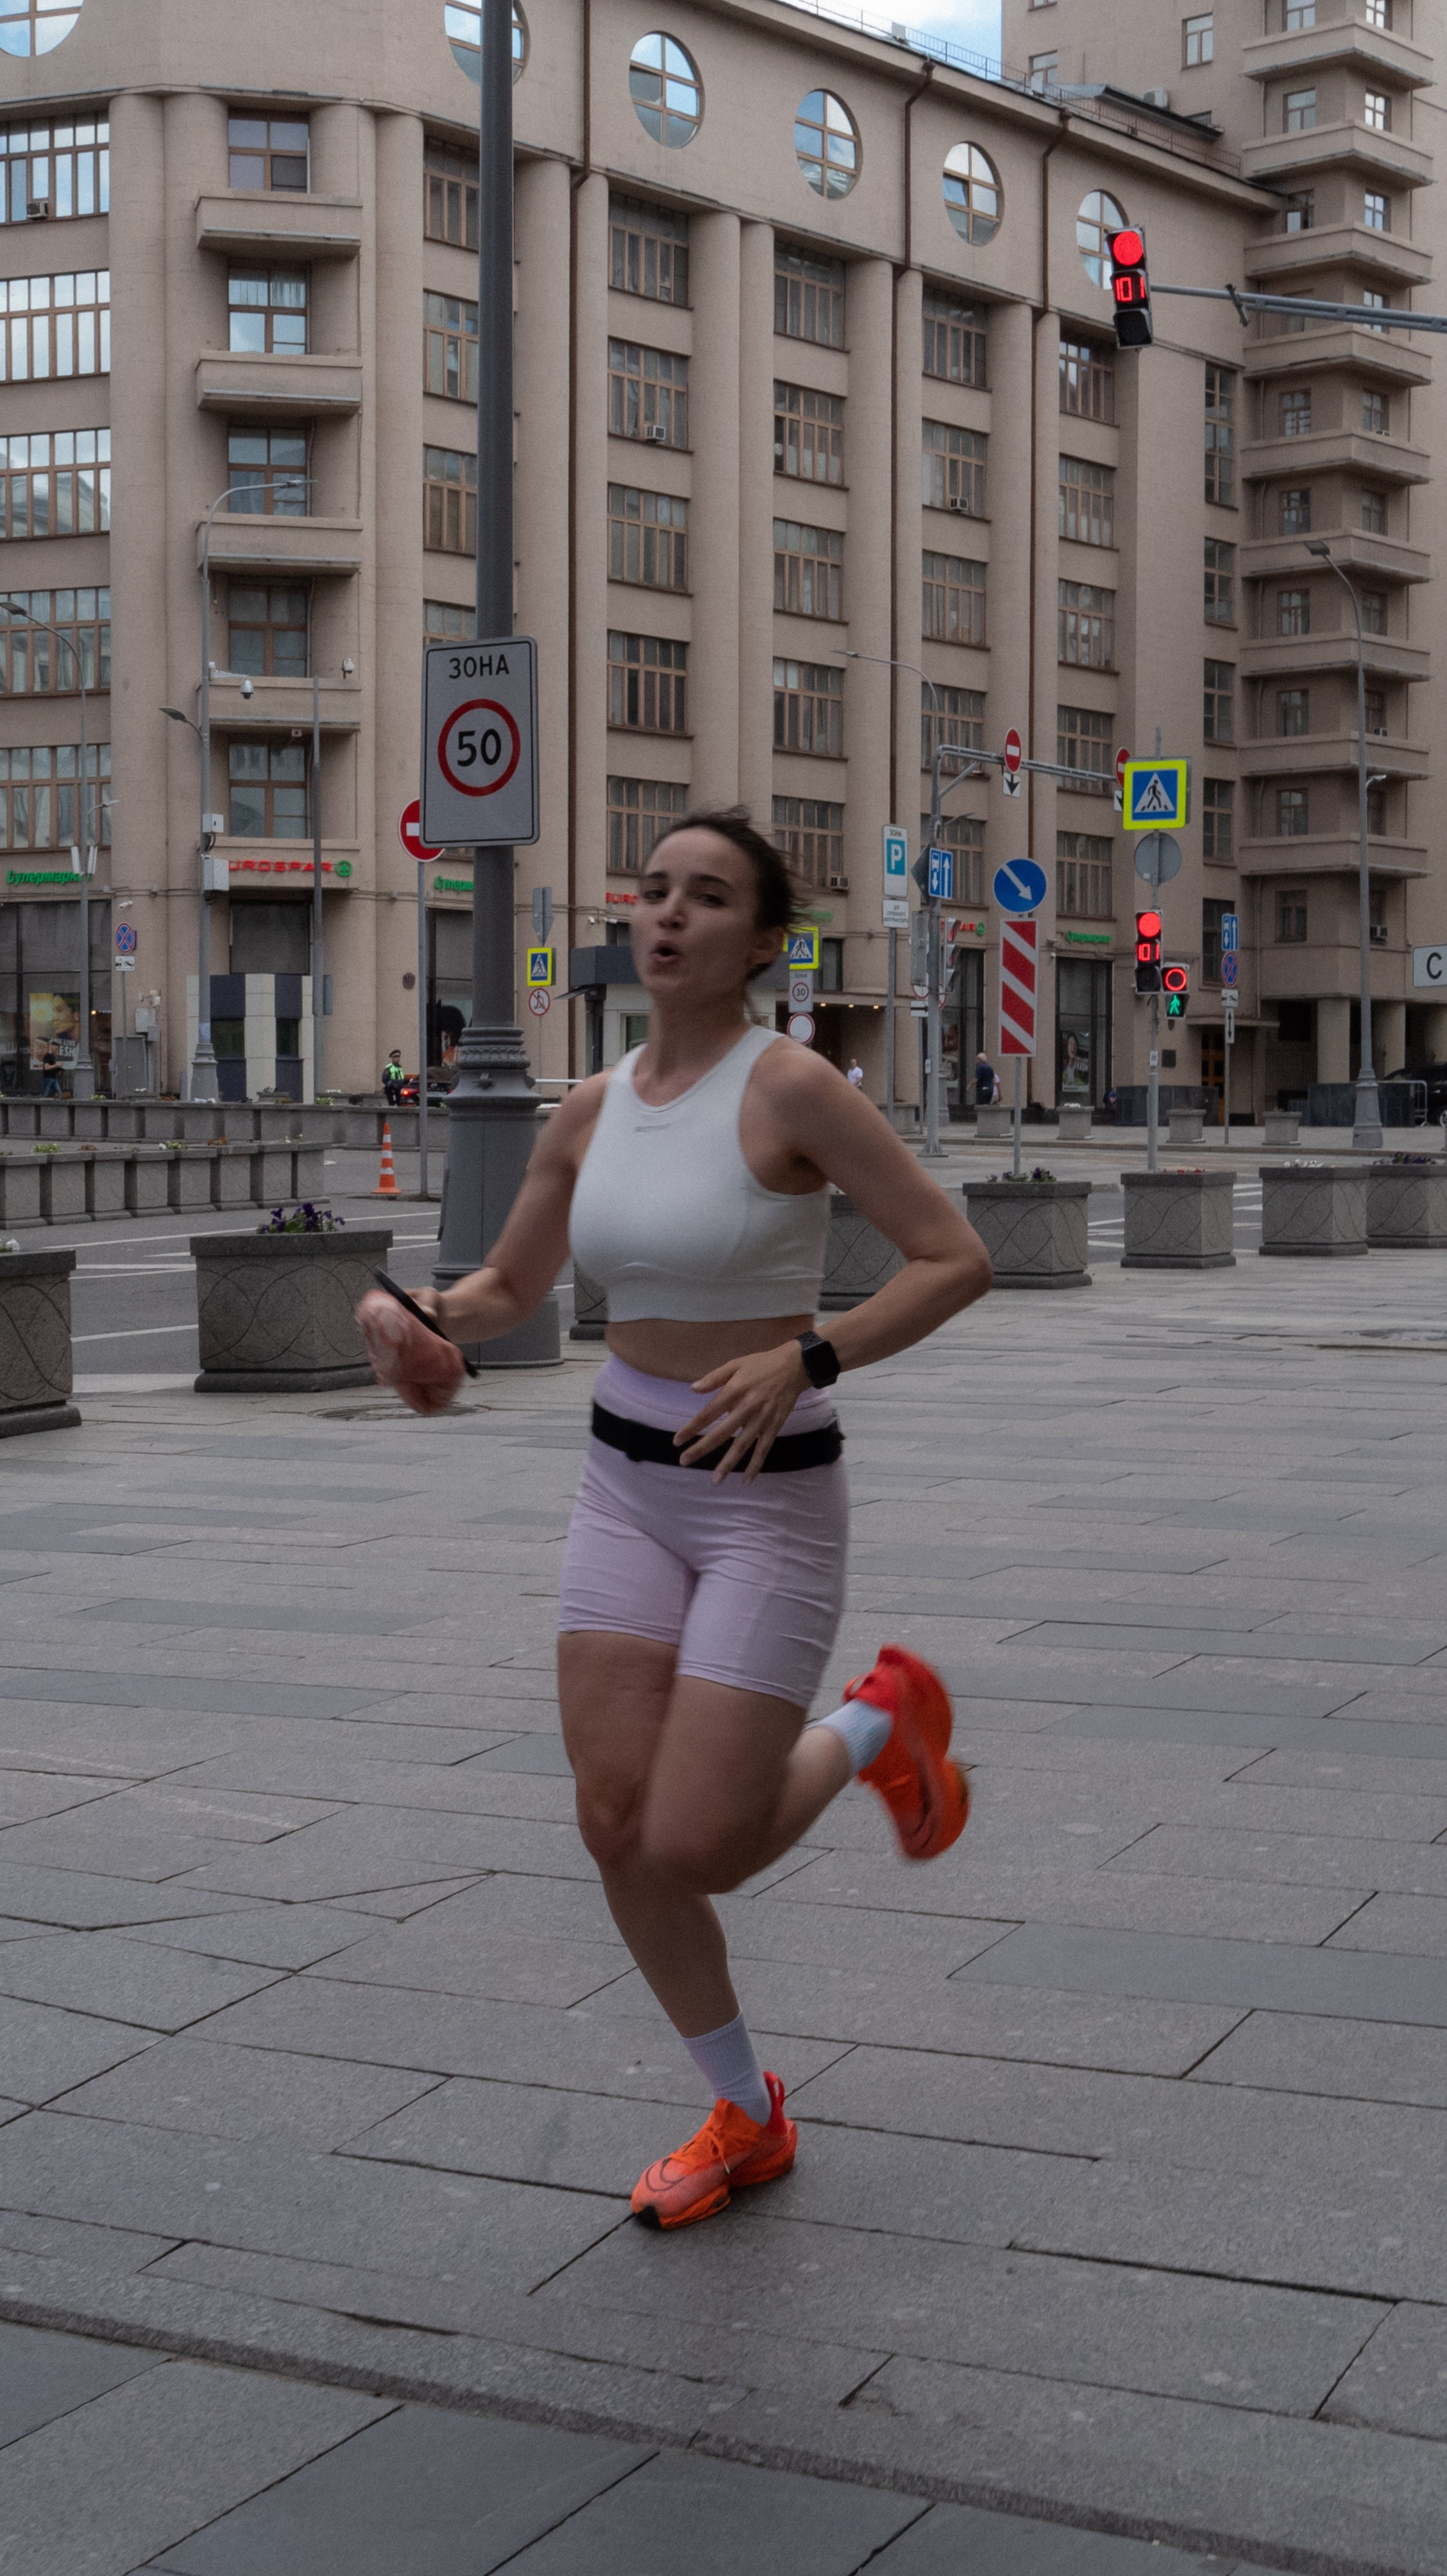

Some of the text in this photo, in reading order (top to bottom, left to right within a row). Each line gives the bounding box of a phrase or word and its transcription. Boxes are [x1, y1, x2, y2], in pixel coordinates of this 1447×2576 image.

[449, 654, 509, 679] ЗОНА
[457, 728, 502, 767] 50
[228, 860, 332, 872] UROSPAR
[891, 843, 902, 870] P
